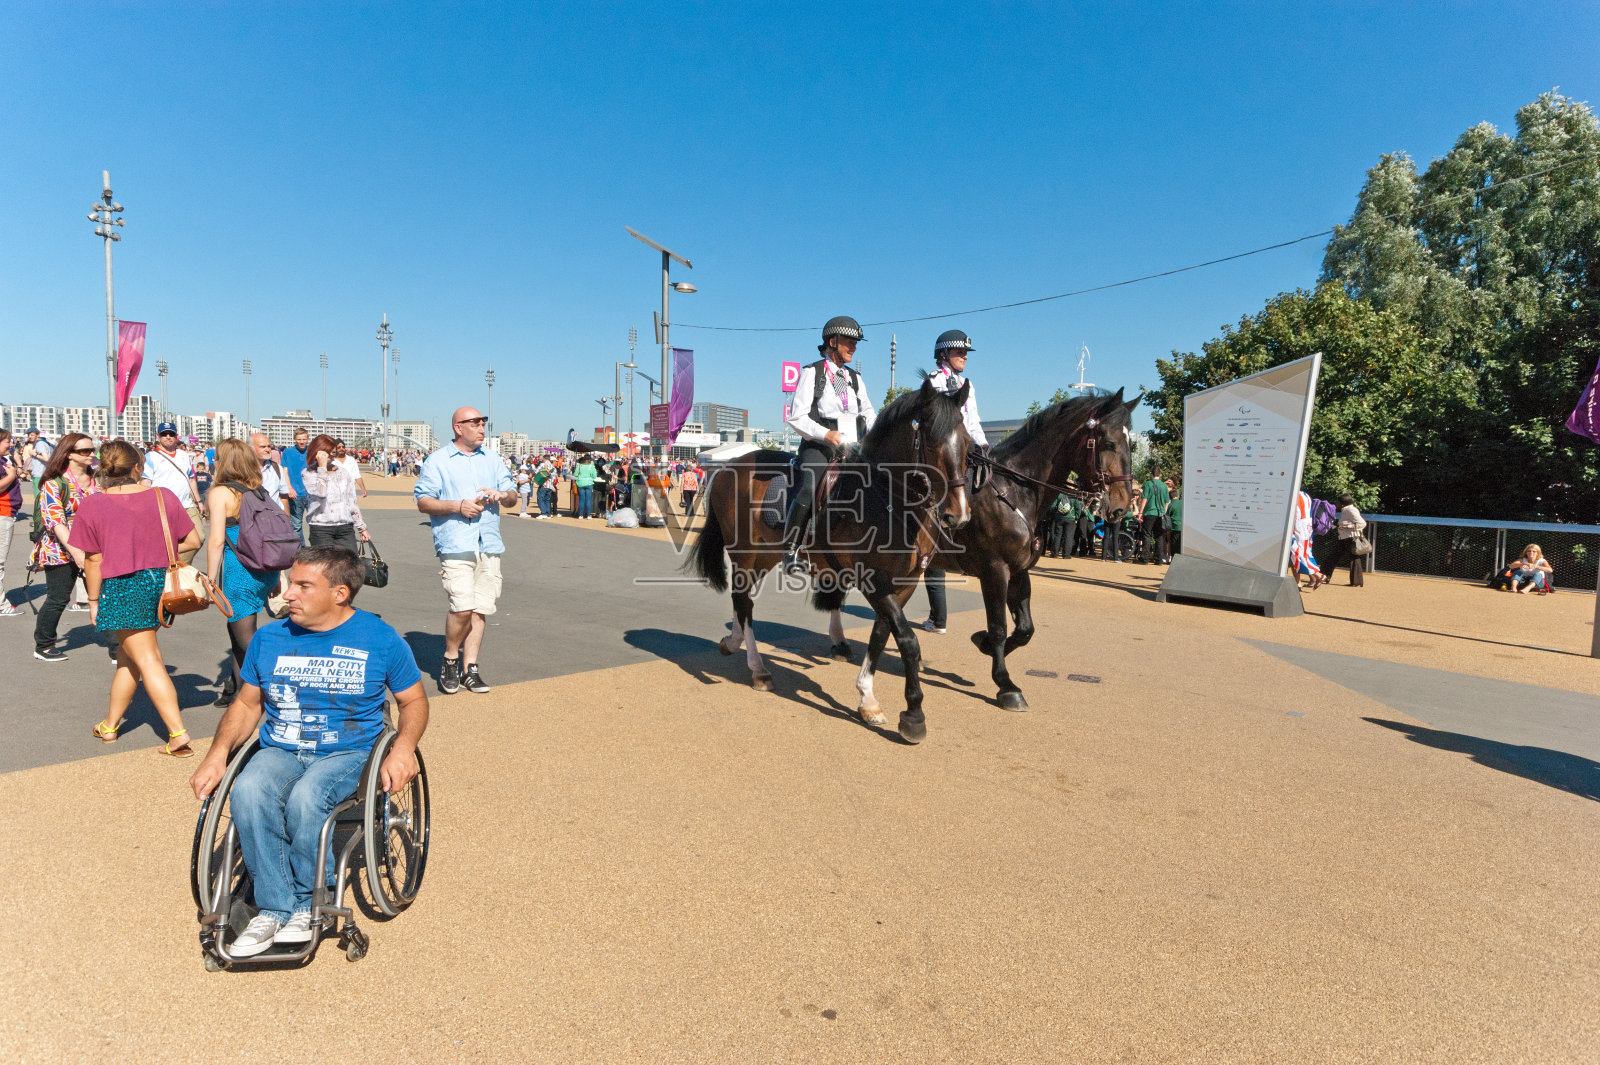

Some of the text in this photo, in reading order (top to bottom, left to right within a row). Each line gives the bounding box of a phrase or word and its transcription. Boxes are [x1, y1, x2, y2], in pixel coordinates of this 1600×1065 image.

[784, 366, 799, 384] D
[334, 647, 355, 656] NEWS
[308, 659, 364, 670] MAD CITY
[275, 666, 363, 678] APPAREL NEWS
